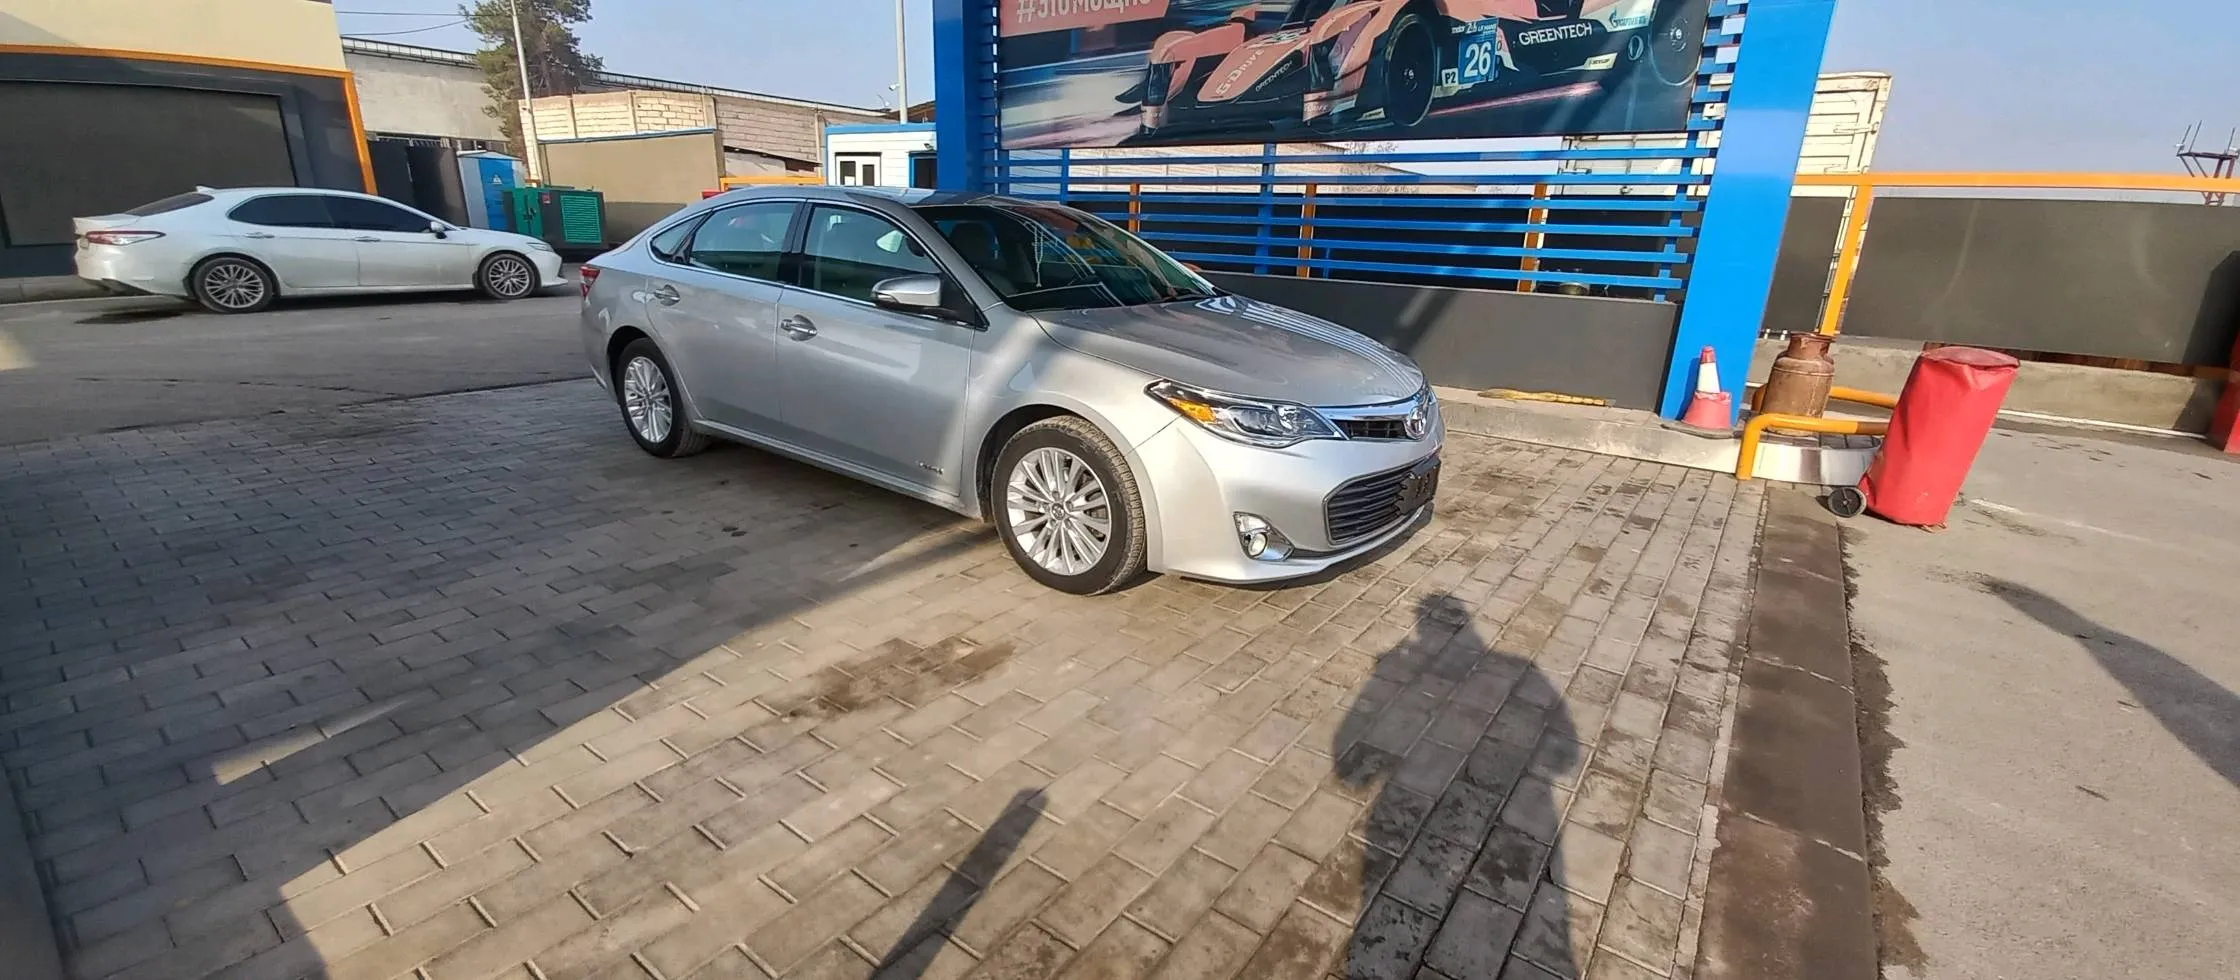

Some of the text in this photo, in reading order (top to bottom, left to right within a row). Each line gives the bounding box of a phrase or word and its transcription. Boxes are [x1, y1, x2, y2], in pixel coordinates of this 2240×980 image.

[1016, 0, 1151, 23] #ЭТОМ
[1519, 22, 1592, 45] GREENTECH
[1464, 41, 1491, 77] 26
[1445, 72, 1456, 84] P2
